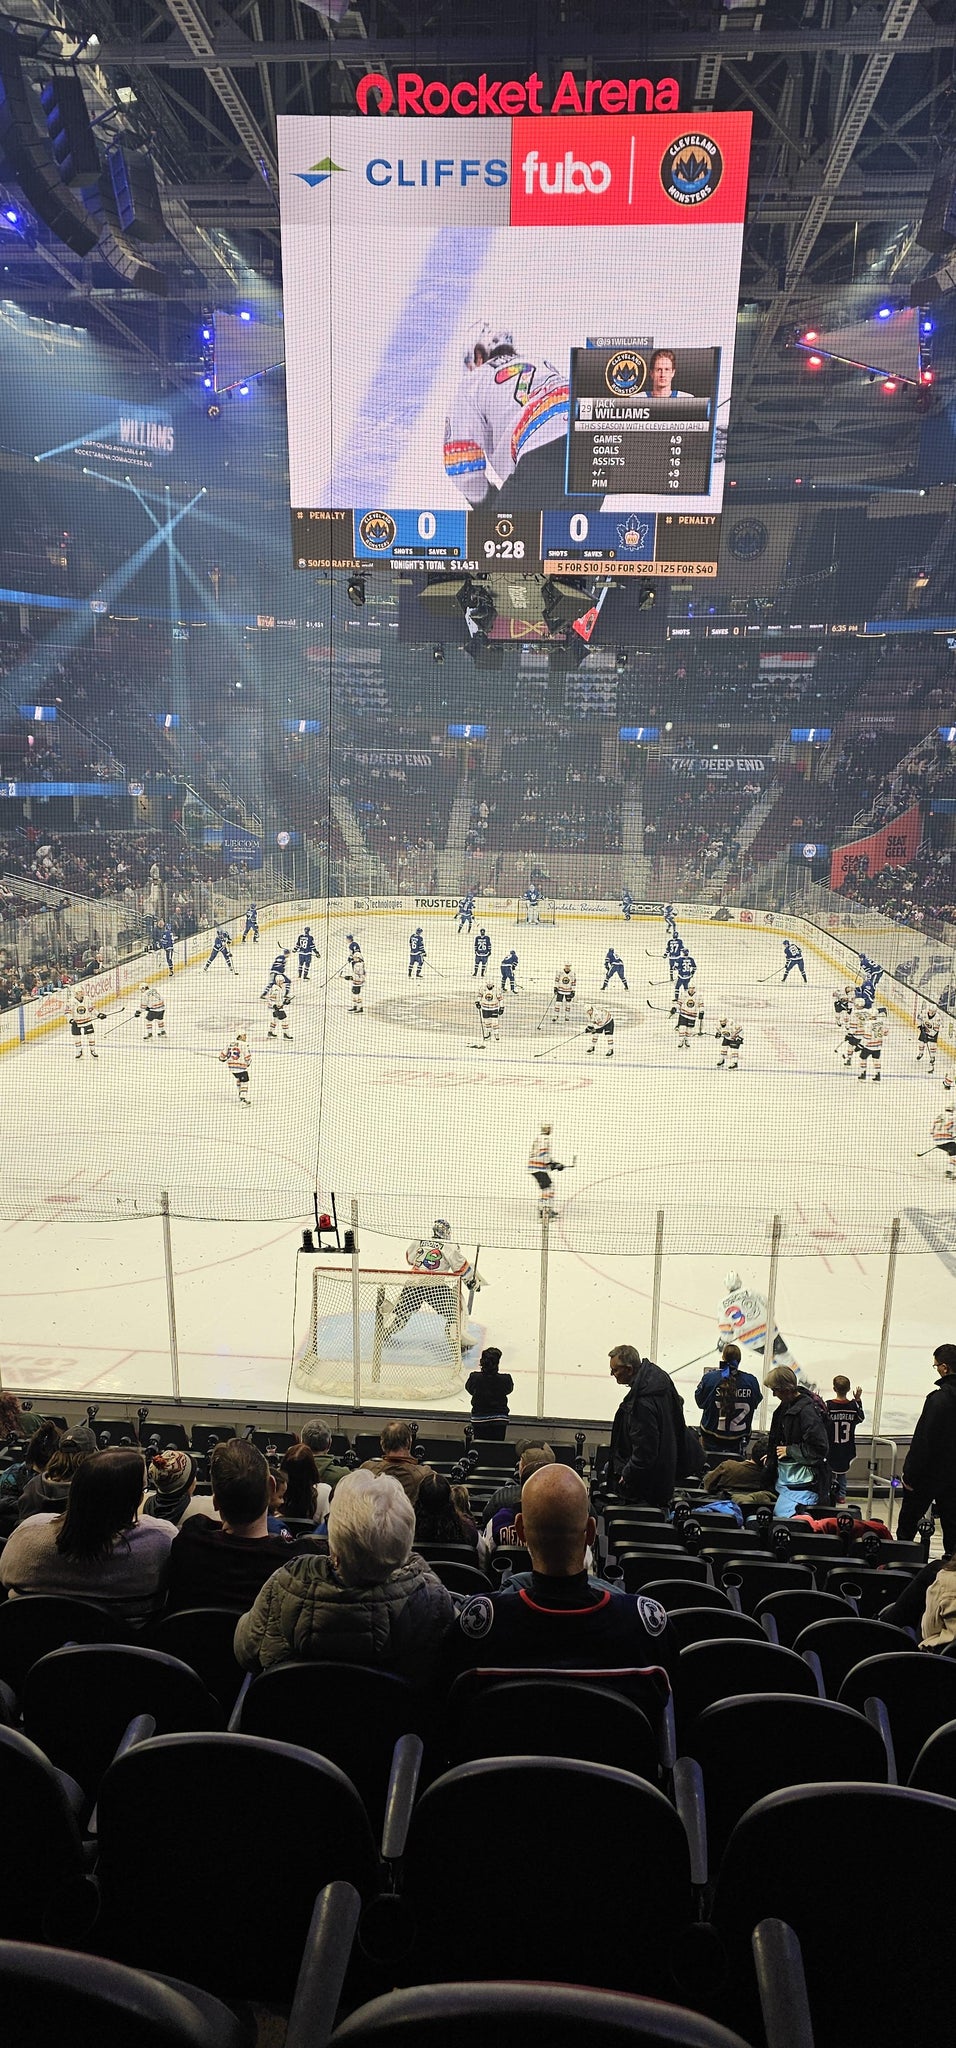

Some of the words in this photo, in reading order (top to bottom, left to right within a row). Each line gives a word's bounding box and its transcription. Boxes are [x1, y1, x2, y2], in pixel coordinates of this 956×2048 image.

[397, 72, 543, 115] Rocket
[551, 71, 679, 114] Arena
[670, 136, 717, 156] CLEVELAND
[365, 158, 509, 187] CLIFFS
[522, 150, 611, 196] fubo
[668, 185, 711, 203] MONSTERS
[612, 353, 642, 365] CLEVELAND
[581, 403, 592, 413] 29
[595, 399, 615, 408] JACK
[594, 407, 651, 420] WILLIAMS
[581, 422, 596, 431] THIS
[597, 422, 625, 431] SEASON
[627, 422, 644, 431] WITH
[645, 422, 685, 431] CLEVELAND
[686, 422, 705, 431] (AHL)
[120, 417, 174, 451] WILLIAMS
[593, 434, 623, 444] GAMES
[670, 435, 683, 444] 49
[593, 446, 619, 455] GOALS
[671, 446, 682, 455] 10
[592, 456, 625, 466] ASSISTS
[669, 457, 680, 466] 16
[591, 468, 606, 477] +/-
[668, 469, 680, 477] +9
[591, 479, 608, 488] PIM
[668, 479, 679, 488] 10
[309, 511, 346, 520] PENALTY
[679, 516, 716, 525] PENALTY
[417, 511, 436, 540] 0
[569, 513, 589, 542] 0
[393, 548, 413, 556] SHOTS
[428, 548, 446, 556] SAVES
[453, 548, 459, 556] 0
[483, 541, 525, 559] 9:28
[548, 550, 568, 558] SHOTS
[583, 550, 603, 558] SAVES
[608, 550, 615, 558] 0
[308, 559, 331, 569] 50/50
[332, 559, 361, 569] RAFFLE
[390, 560, 425, 570] TONIGHT'S
[426, 560, 446, 570] TOTAL
[450, 560, 480, 571] $1,451
[557, 563, 564, 573] 5
[565, 563, 582, 573] FOR
[583, 563, 599, 574] $10
[604, 564, 616, 573] 50
[616, 564, 634, 573] FOR
[635, 564, 654, 574] $20
[660, 564, 676, 574] 125
[676, 565, 694, 574] FOR
[695, 565, 714, 575] $40
[672, 628, 691, 636] SHOTS
[711, 627, 729, 636] SAVES
[831, 624, 847, 633] 6:35
[405, 753, 433, 767] END
[700, 758, 735, 772] DEEP
[737, 758, 765, 772] END
[887, 836, 908, 847] SEAT
[477, 941, 487, 951] 26
[669, 943, 680, 953] 37
[834, 1421, 850, 1443] 13
